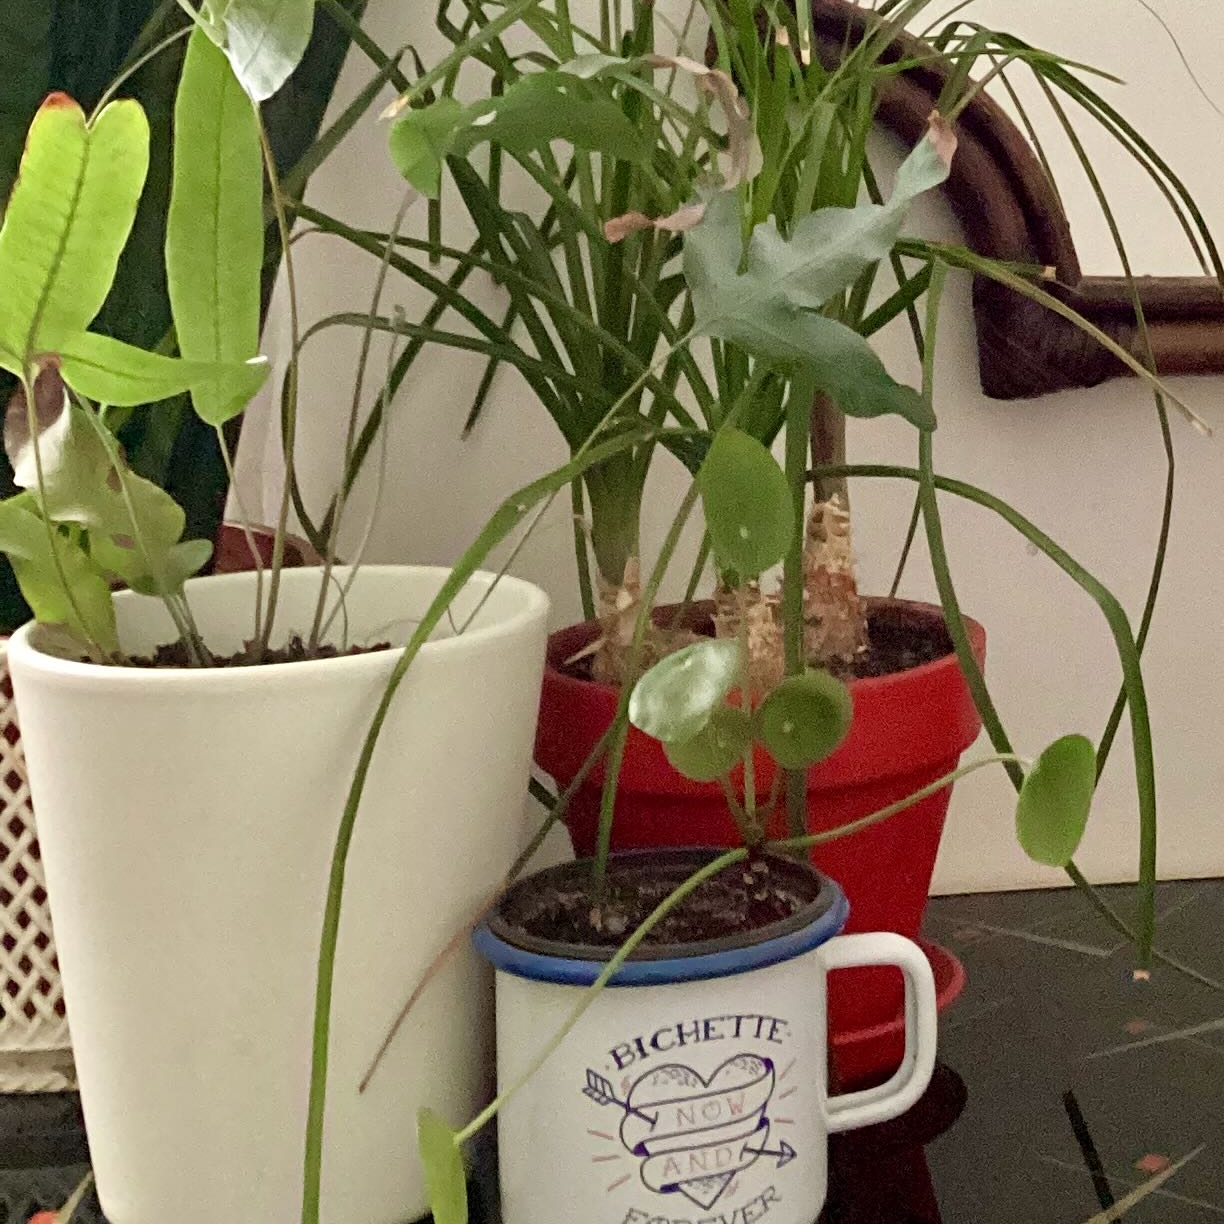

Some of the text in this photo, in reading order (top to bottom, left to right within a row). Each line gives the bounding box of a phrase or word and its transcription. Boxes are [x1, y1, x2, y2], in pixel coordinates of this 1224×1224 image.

[609, 1014, 788, 1070] BICHETTE
[676, 1093, 745, 1127] NOW
[663, 1147, 732, 1178] AND
